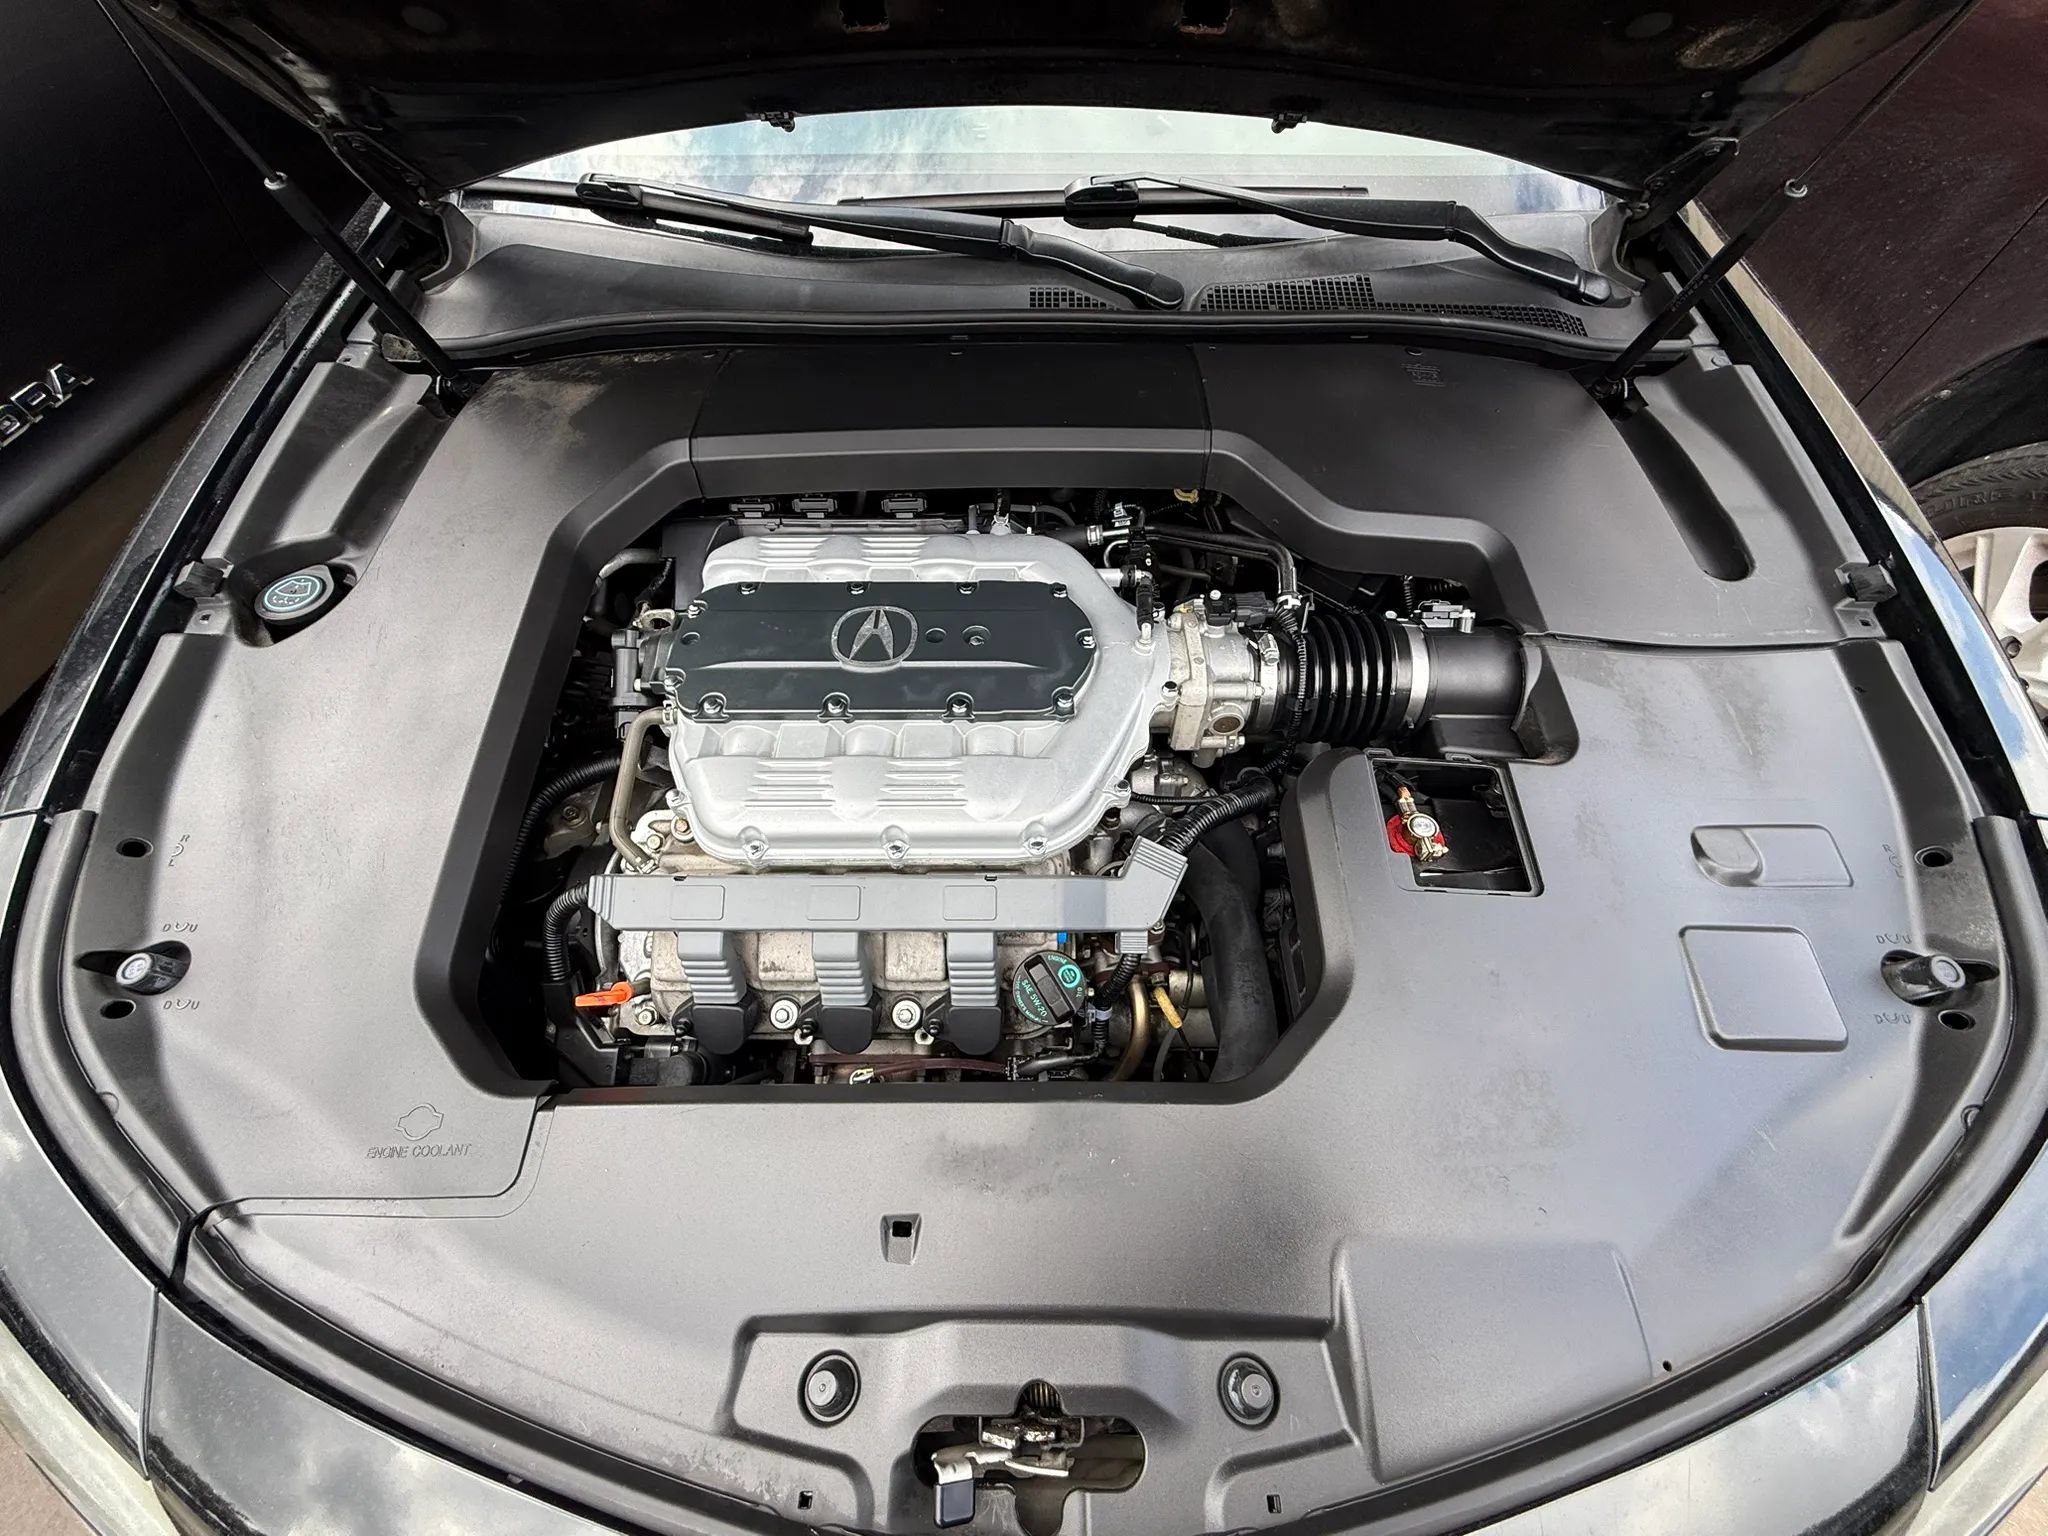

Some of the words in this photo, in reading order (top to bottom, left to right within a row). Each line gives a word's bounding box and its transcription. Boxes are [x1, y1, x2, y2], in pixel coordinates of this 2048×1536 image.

[1047, 954, 1068, 965] ENGINE
[1021, 979, 1033, 994] SAE
[1030, 994, 1048, 1017] 5W-20
[367, 1146, 409, 1159] ENGINE
[412, 1143, 472, 1158] COOLANT
